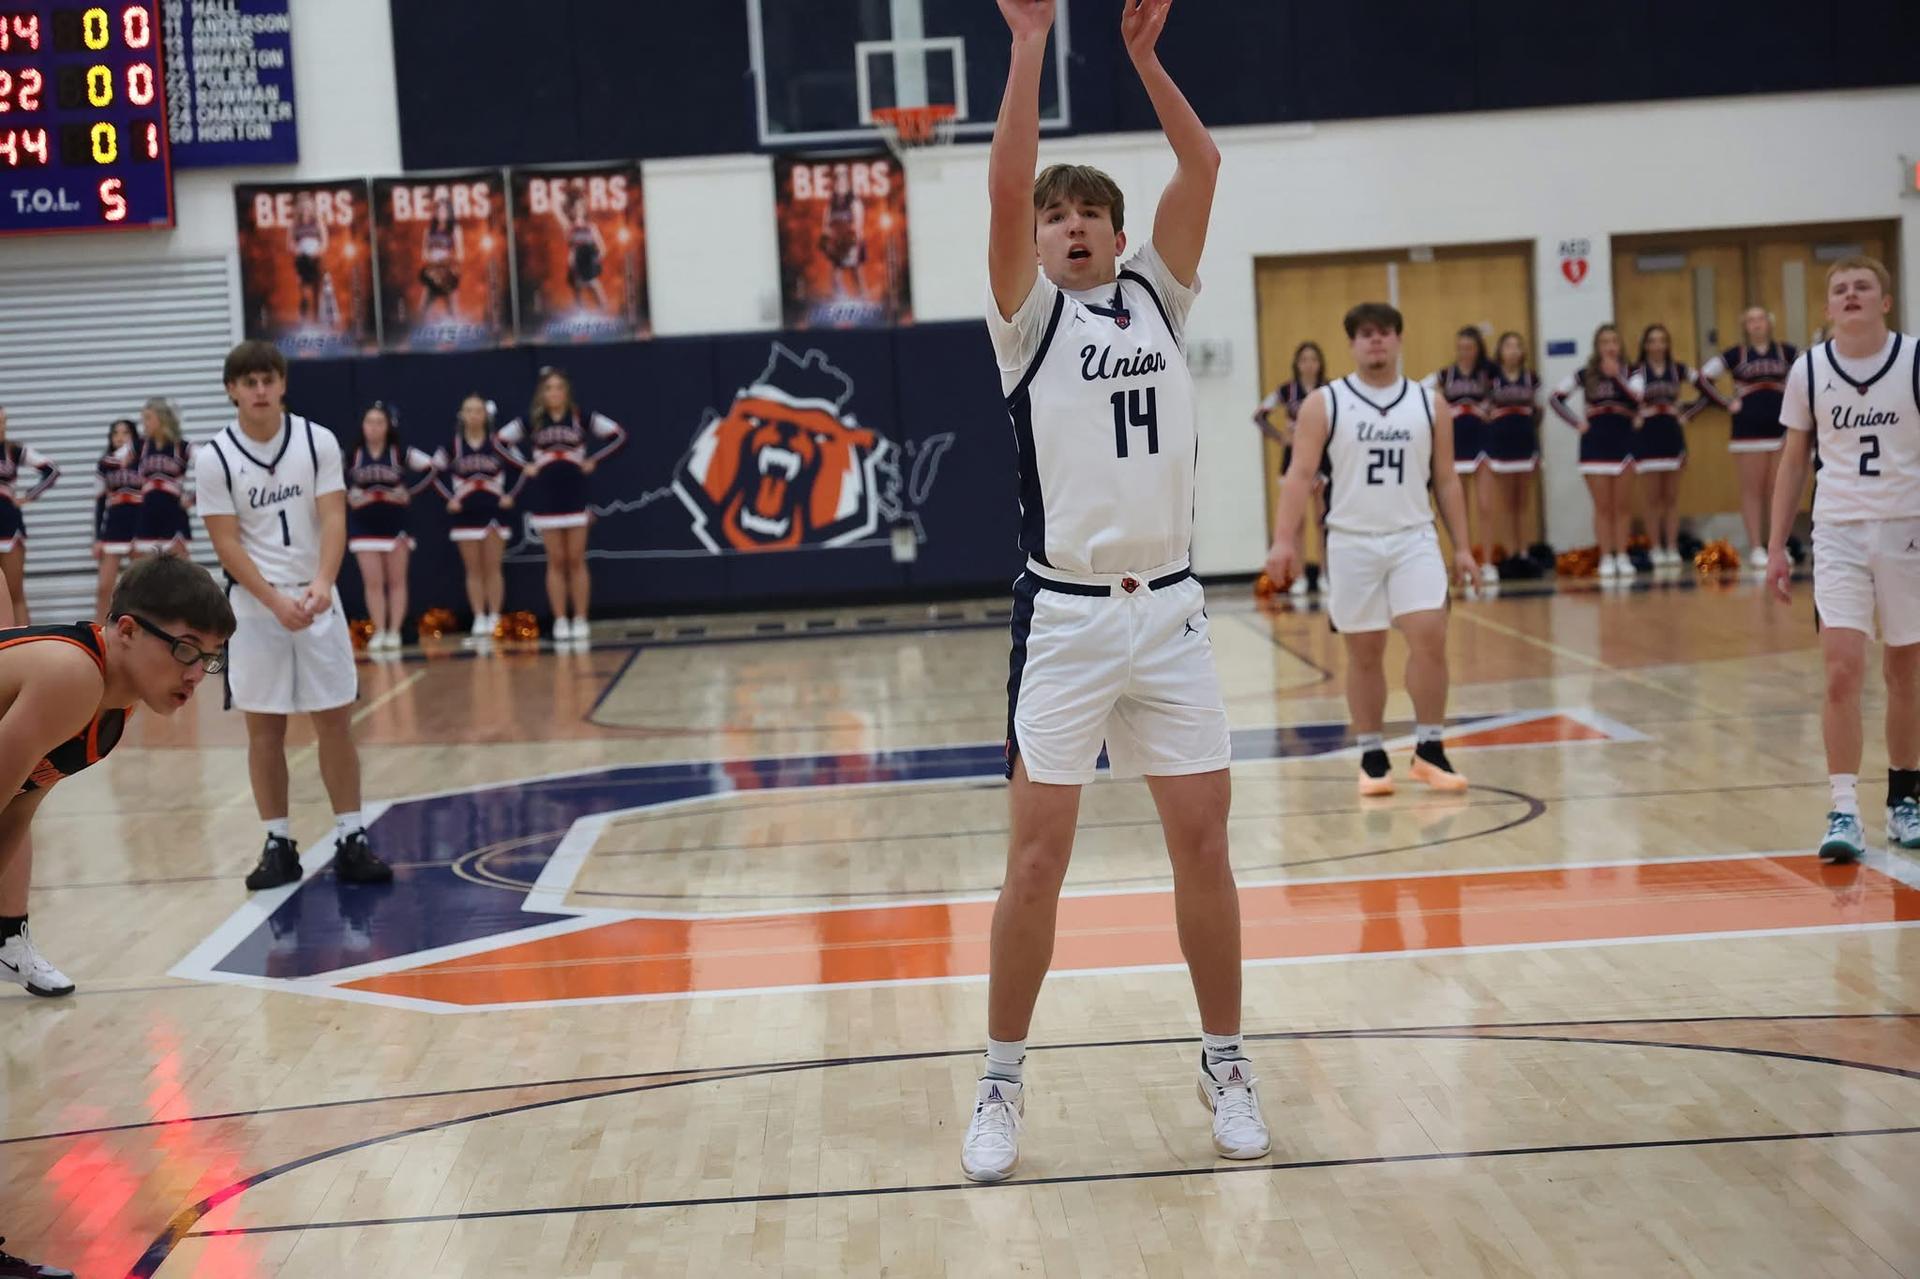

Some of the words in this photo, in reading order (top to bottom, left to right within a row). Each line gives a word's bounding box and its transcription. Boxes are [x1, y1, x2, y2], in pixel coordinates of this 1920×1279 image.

[83, 7, 110, 50] 0
[123, 5, 150, 49] 0
[193, 13, 290, 33] ANDERSON
[193, 49, 283, 70] WHARTON
[87, 64, 113, 107] 0
[127, 62, 154, 106] 0
[197, 102, 292, 122] CHANDLER
[91, 121, 118, 164] 0
[147, 122, 159, 159] 1
[529, 175, 628, 214] BERS
[792, 161, 890, 200] BERS
[10, 187, 80, 213] T.O.L.
[254, 190, 353, 228] BERS
[1080, 345, 1166, 381] Union
[1110, 387, 1159, 458] 14
[1357, 421, 1410, 443] Union
[1831, 405, 1899, 430] Union
[1367, 448, 1404, 485] 24
[1859, 435, 1881, 476] 2
[248, 482, 303, 510] Union
[277, 510, 292, 548] 1
